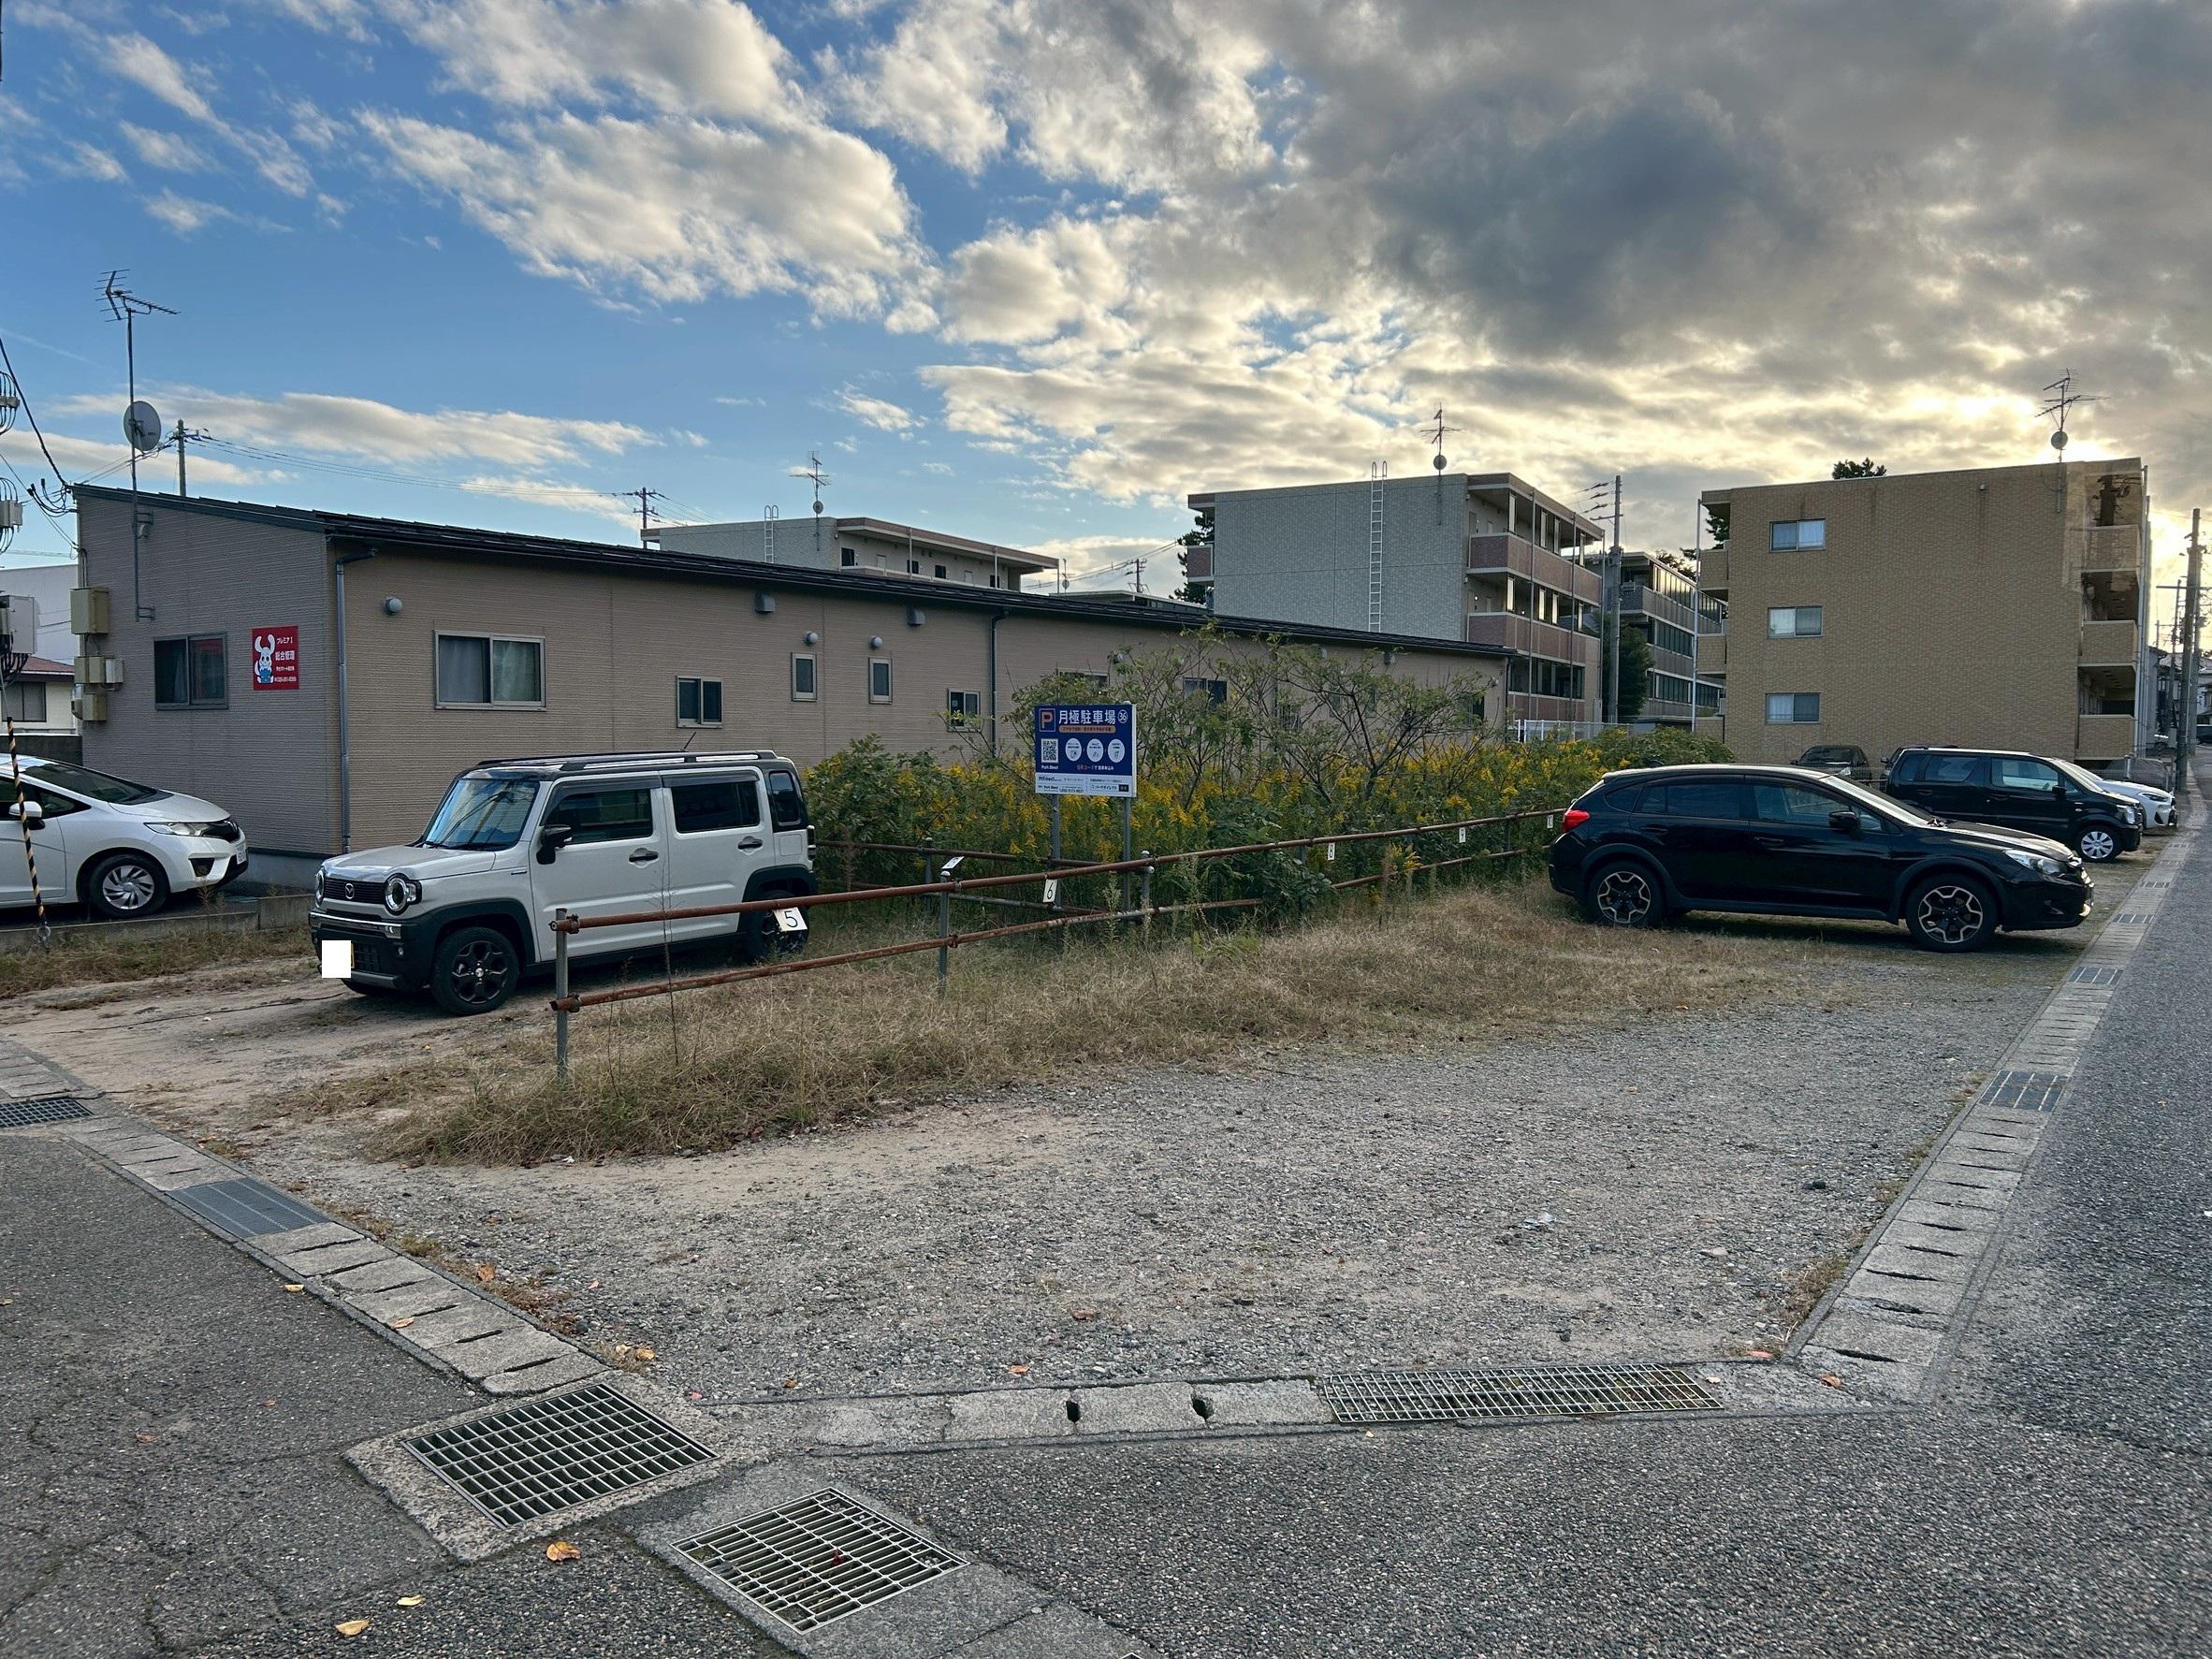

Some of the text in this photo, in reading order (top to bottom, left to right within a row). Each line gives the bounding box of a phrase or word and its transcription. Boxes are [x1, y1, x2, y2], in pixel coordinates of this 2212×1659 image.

[1041, 711, 1053, 729] P
[1058, 709, 1116, 725] 月極駐車場
[1047, 881, 1054, 900] 6
[784, 910, 798, 928] 5
